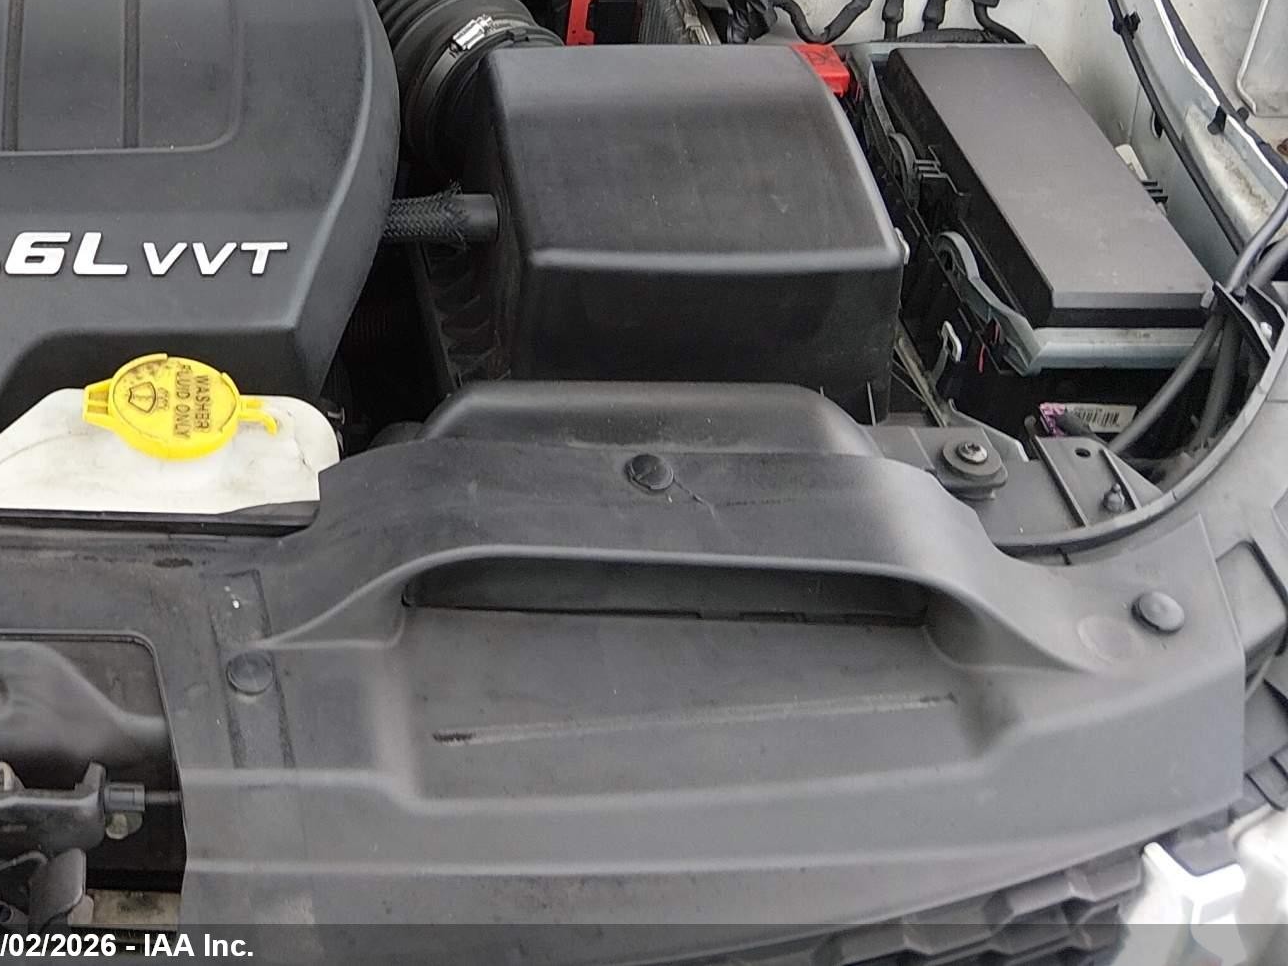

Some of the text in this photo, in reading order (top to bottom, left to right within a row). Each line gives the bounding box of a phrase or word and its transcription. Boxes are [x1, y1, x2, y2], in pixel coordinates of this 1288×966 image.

[143, 241, 289, 276] VVT
[176, 364, 192, 438] FLUID ONLY
[196, 375, 210, 429] WASHER
